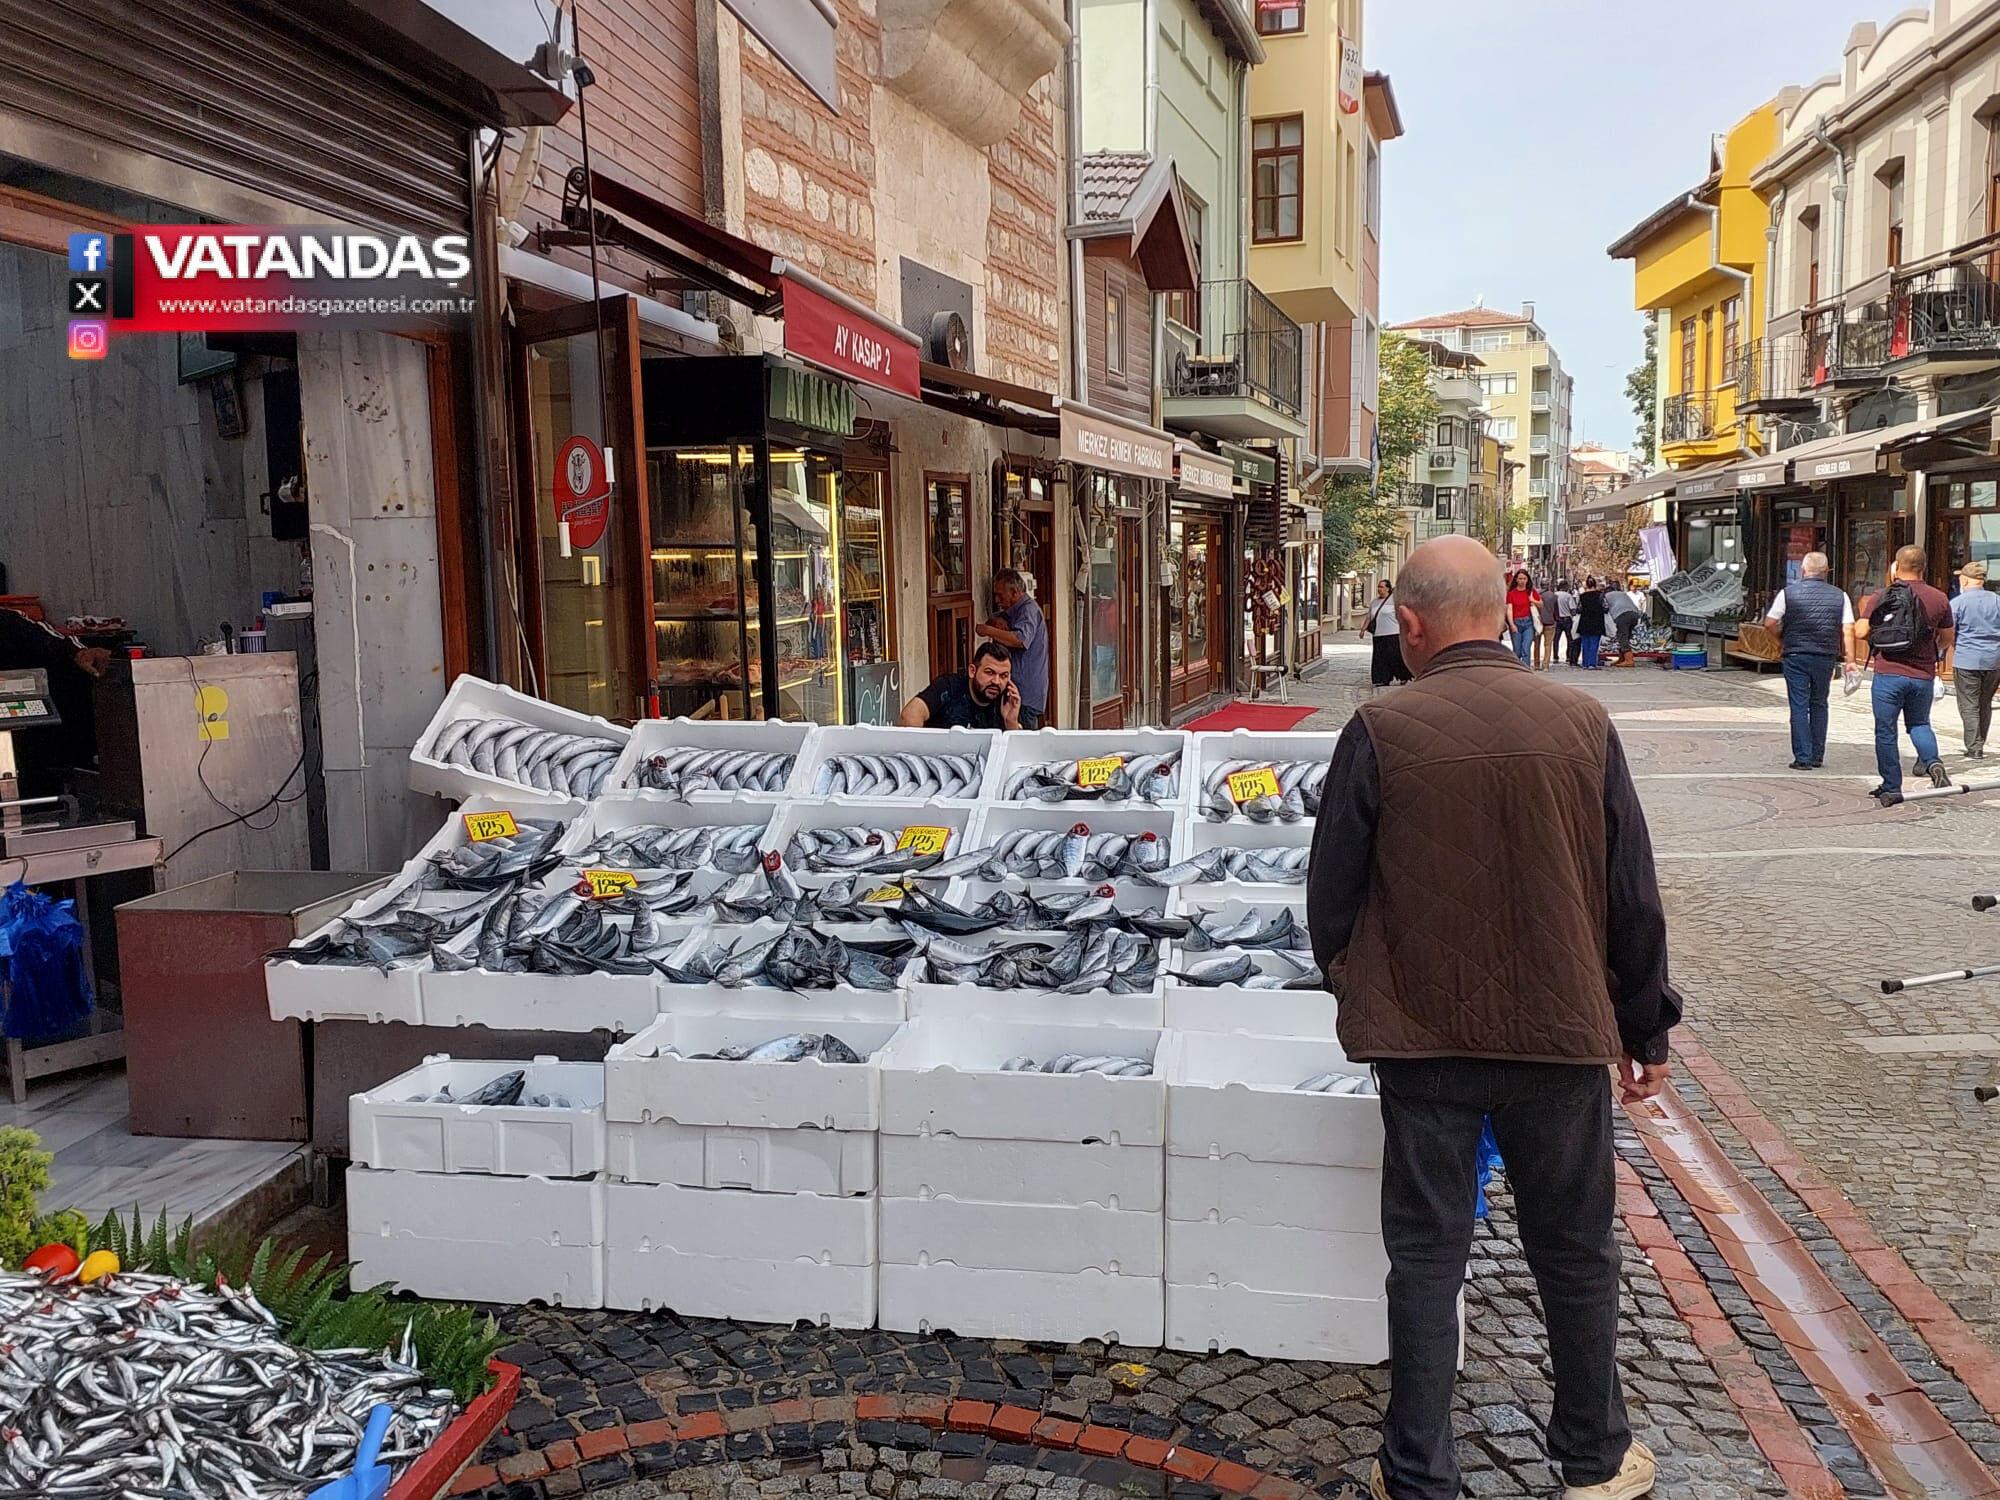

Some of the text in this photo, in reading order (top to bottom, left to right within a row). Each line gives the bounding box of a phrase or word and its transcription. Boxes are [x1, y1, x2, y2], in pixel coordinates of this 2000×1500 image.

[834, 324, 891, 376] AY KASAP 2
[786, 368, 806, 422] AY
[1078, 429, 1108, 459] MERKEZ
[1110, 438, 1132, 464] EKMEK
[1088, 767, 1110, 783] 125
[1240, 779, 1266, 799] 125
[477, 820, 505, 838] 125
[910, 834, 934, 852] 125
